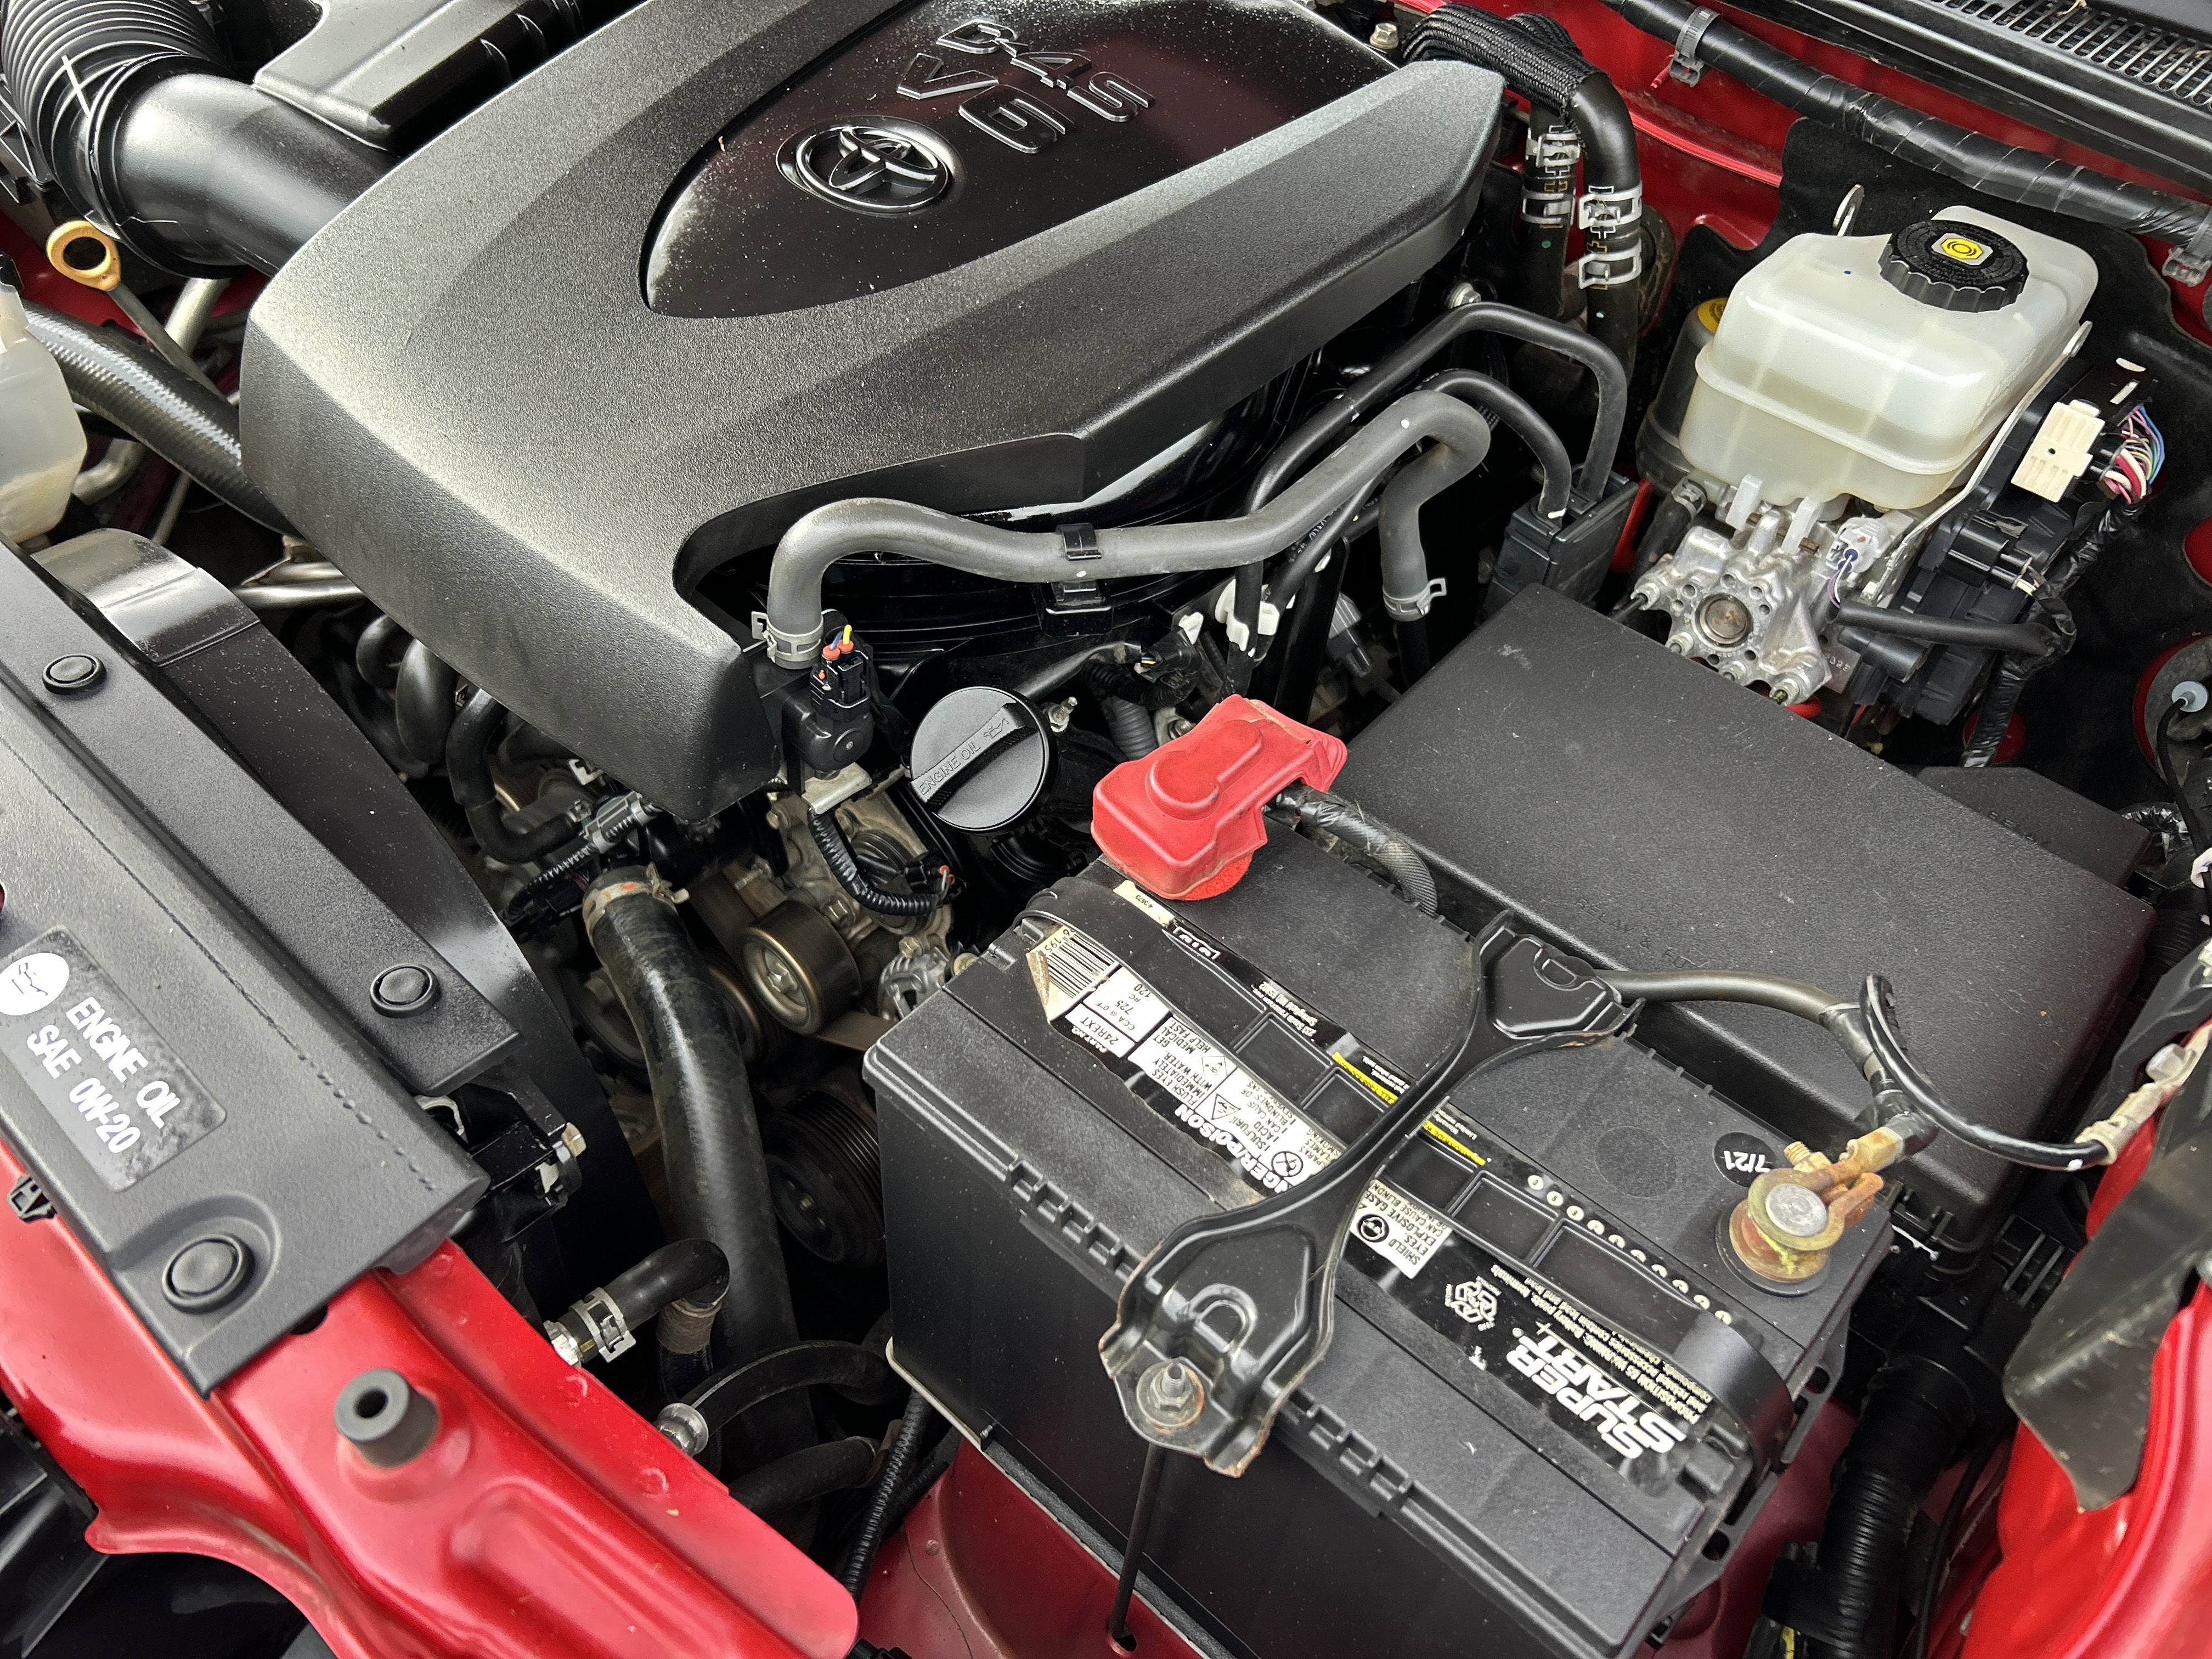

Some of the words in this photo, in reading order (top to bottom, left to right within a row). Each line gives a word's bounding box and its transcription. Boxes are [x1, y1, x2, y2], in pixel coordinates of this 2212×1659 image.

[918, 755, 962, 796] ENGINE
[961, 742, 981, 760] OIL
[1128, 992, 1141, 1003] RC
[1133, 982, 1152, 997] 120
[1114, 998, 1133, 1015] 725
[1117, 1015, 1136, 1031] CCA
[1169, 1020, 1190, 1038] FAST.
[1084, 1036, 1107, 1053] PART
[1152, 1034, 1170, 1047] GET
[1160, 1026, 1195, 1054] MEDICAL
[1189, 1035, 1210, 1053] HELP
[66, 996, 149, 1083] ENGINE
[137, 1081, 180, 1129] OIL
[1163, 1050, 1192, 1075] WATER.
[27, 1024, 82, 1079] SAE
[69, 1077, 141, 1153] 0W-20
[1152, 1068, 1172, 1087] EYES
[1153, 1058, 1205, 1098] IMMEDIATELY
[1190, 1071, 1212, 1091] WITH
[1171, 1083, 1197, 1105] FLUSH
[1246, 1099, 1267, 1119] CAUS
[1254, 1092, 1288, 1126] BLINDNES
[1252, 1120, 1274, 1140] ACID
[1265, 1118, 1280, 1133] CAN
[1173, 1104, 1291, 1193] NGER/POISON
[1306, 1127, 1339, 1155] SMOKING
[1724, 1150, 1770, 1173] 7/21
[1363, 1188, 1389, 1211] GASE
[1370, 1181, 1401, 1206] BLINDN
[1399, 1204, 1427, 1226] CAUSE
[1386, 1207, 1436, 1246] EXPLOSIVE
[1425, 1222, 1443, 1237] CAN
[1388, 1238, 1421, 1265] SHIELD
[1403, 1232, 1429, 1255] EYES.
[1624, 1364, 1641, 1380] 65
[1504, 1343, 1652, 1459] SUPER
[1517, 1335, 1687, 1454] START
[1635, 1373, 1700, 1425] PROPOSITION
[1685, 1395, 1707, 1414] and
